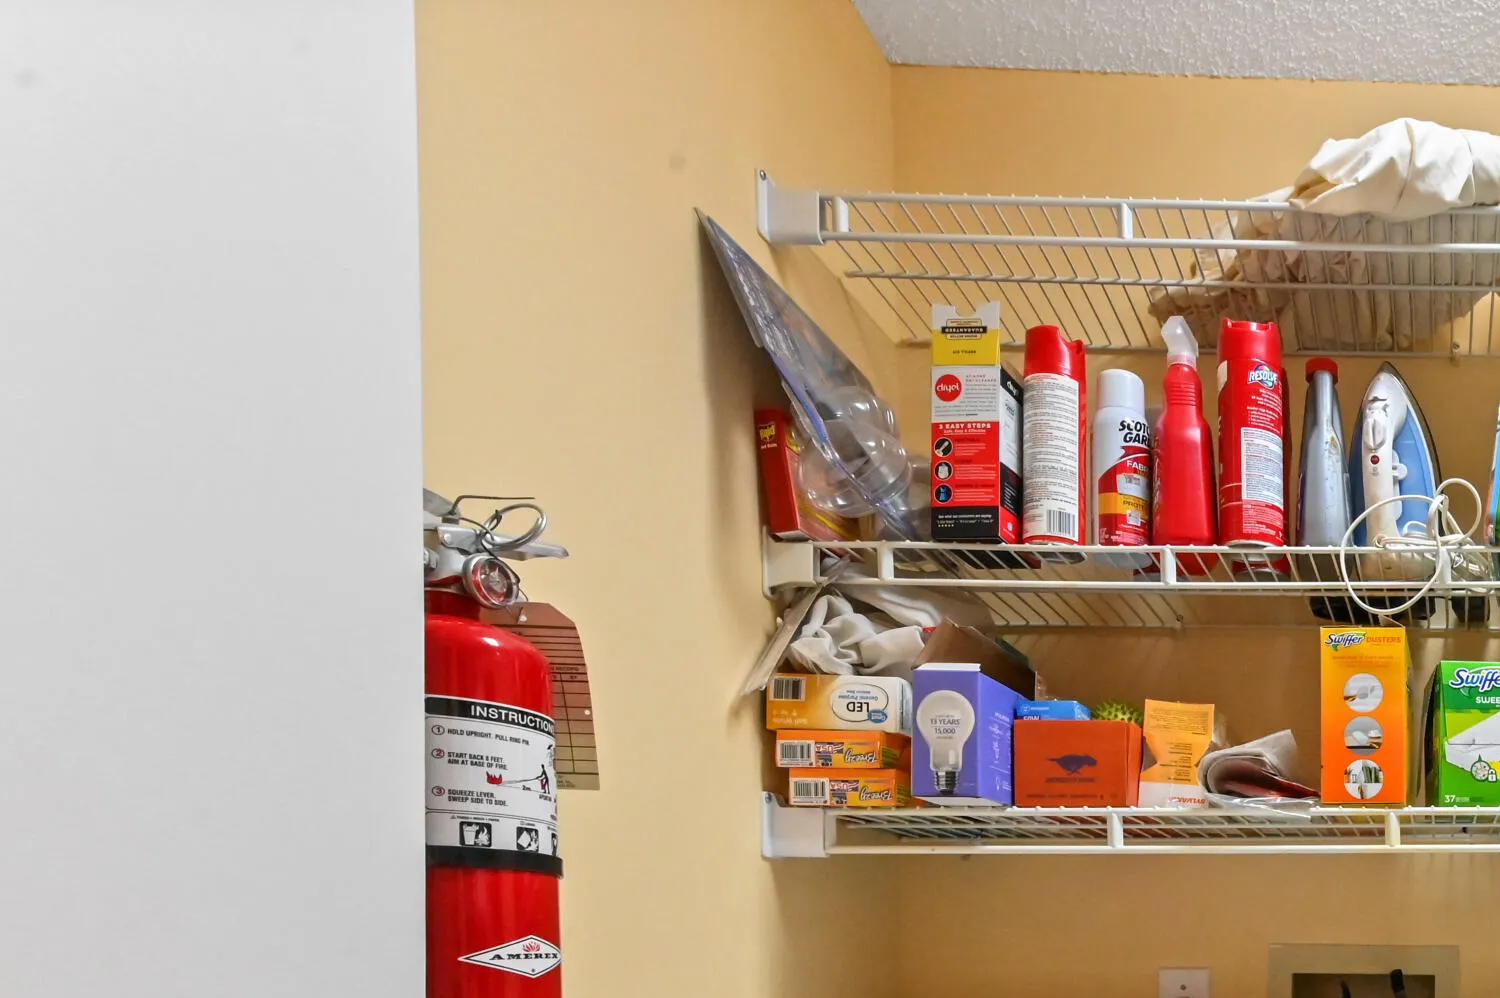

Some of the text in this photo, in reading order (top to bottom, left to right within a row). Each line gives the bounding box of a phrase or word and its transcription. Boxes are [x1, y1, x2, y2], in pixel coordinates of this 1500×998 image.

[1248, 371, 1278, 384] RESOLVE
[1325, 633, 1364, 647] Swiffer
[846, 701, 870, 713] LED
[938, 718, 960, 726] YEARS
[447, 728, 464, 736] HOLD
[495, 734, 508, 742] PULL
[447, 751, 467, 759] START
[469, 753, 484, 761] BACK
[845, 747, 877, 763] Breezy
[470, 760, 485, 768] BASE
[447, 788, 475, 797] SQUEEZE
[860, 785, 893, 801] Breezy
[1444, 795, 1456, 803] 37
[489, 952, 559, 961] AMEREX
